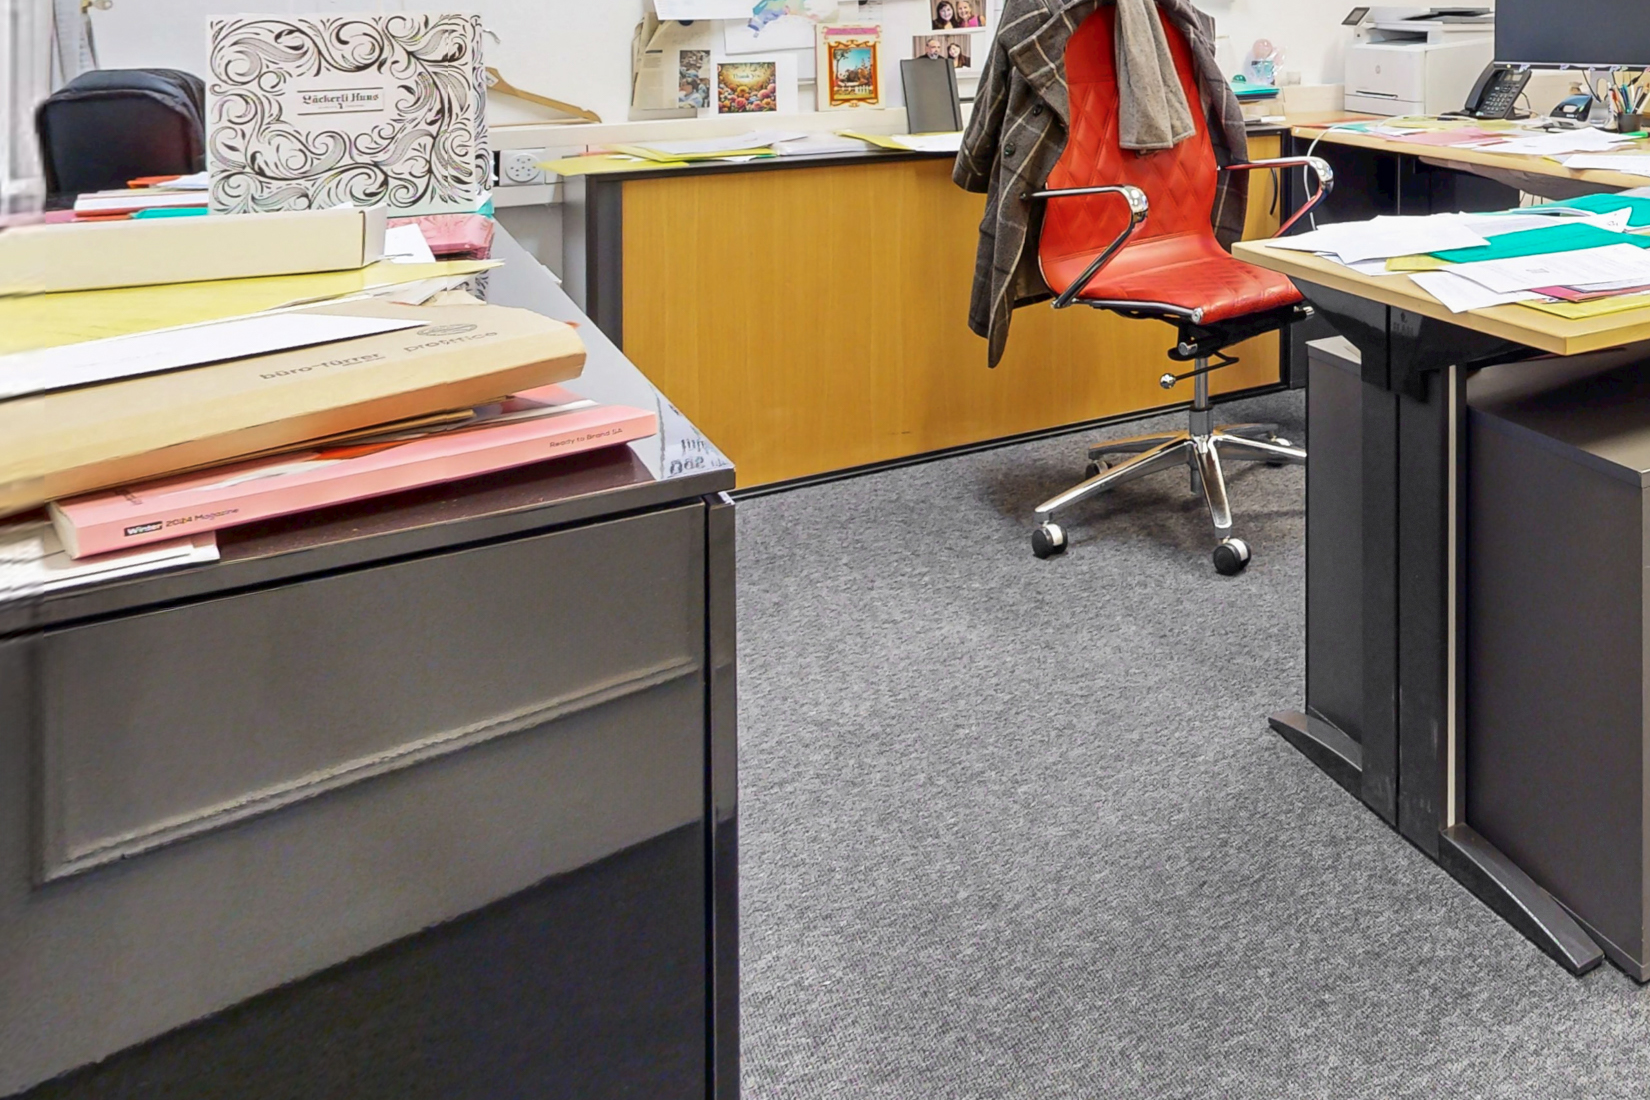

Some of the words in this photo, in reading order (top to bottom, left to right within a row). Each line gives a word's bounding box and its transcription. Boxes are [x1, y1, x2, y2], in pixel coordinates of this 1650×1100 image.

[549, 437, 576, 448] Ready
[576, 435, 585, 443] to
[586, 429, 611, 441] Brand
[126, 521, 163, 536] Winter
[194, 507, 240, 521] Magazine
